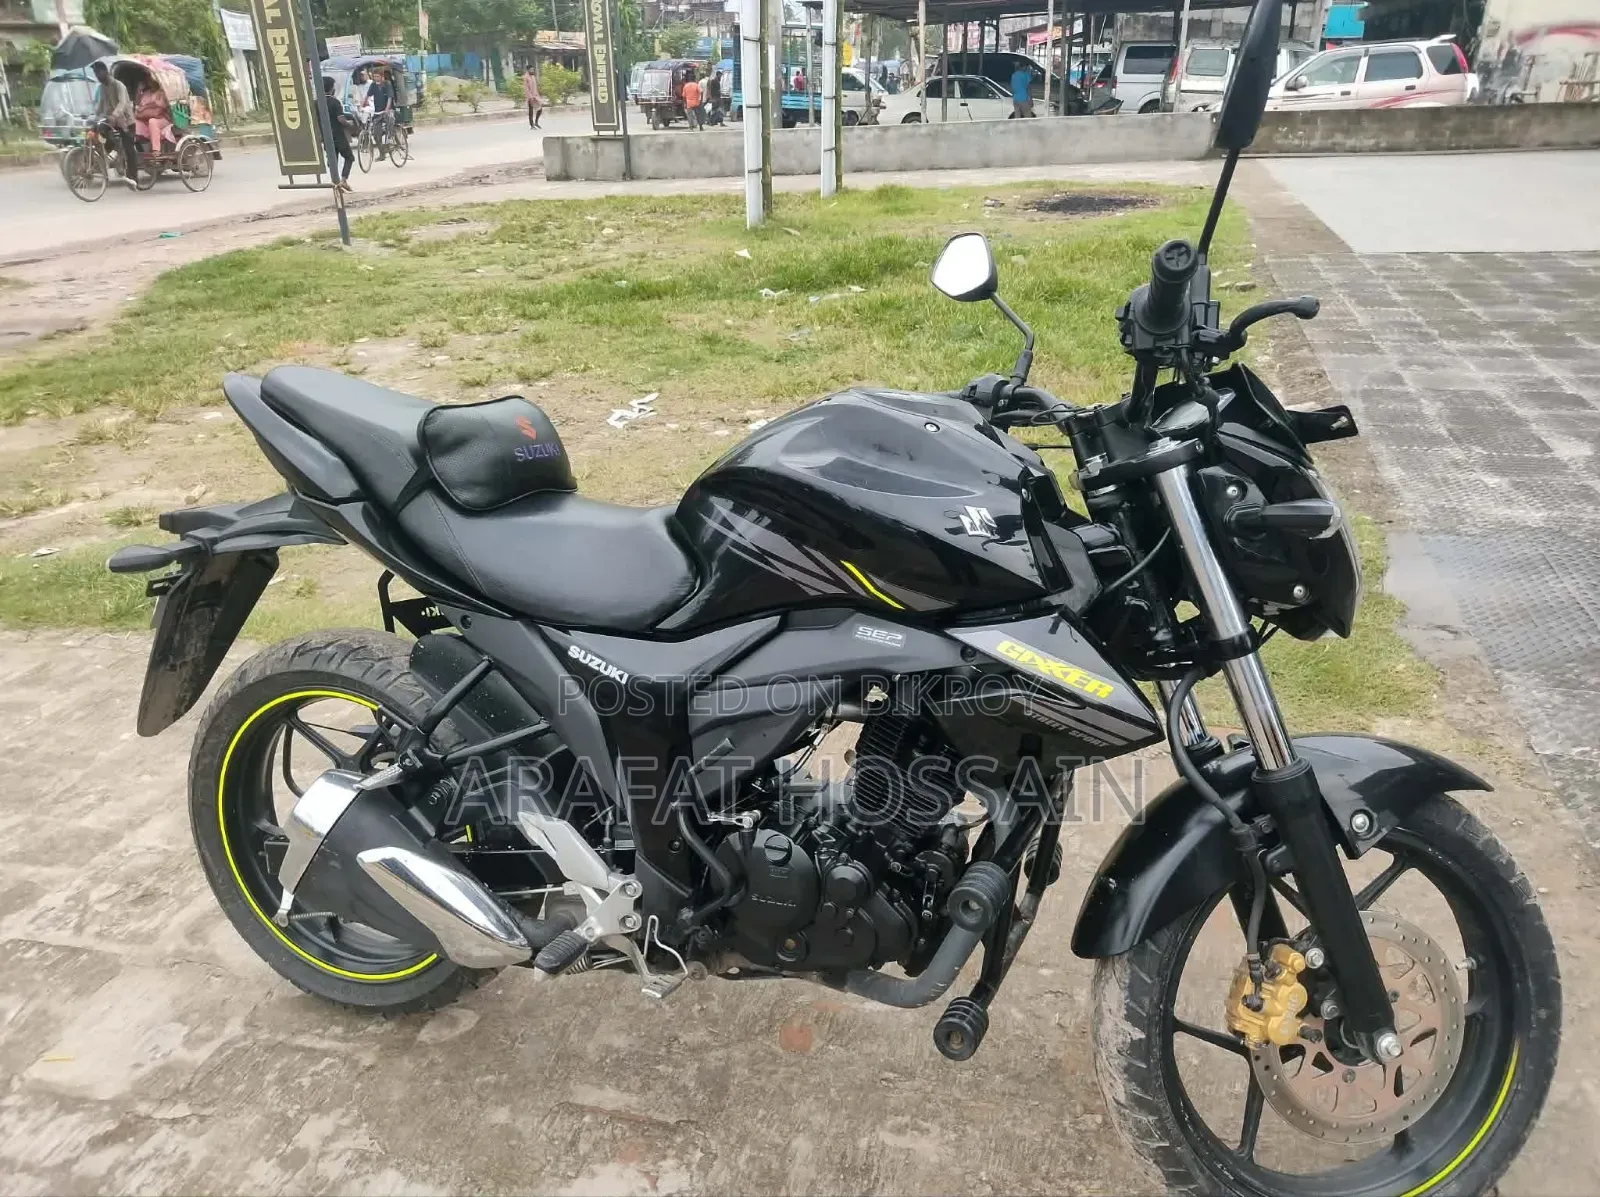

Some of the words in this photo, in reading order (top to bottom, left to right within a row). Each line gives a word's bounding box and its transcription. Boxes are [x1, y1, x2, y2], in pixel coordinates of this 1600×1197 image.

[590, 0, 604, 42] OYAL
[266, 28, 301, 130] ENFIELD
[593, 44, 609, 104] ENFIELD
[514, 443, 561, 462] SUZUKI
[567, 644, 629, 685] SUZUKI
[996, 640, 1114, 699] GIXXER
[1069, 730, 1112, 748] SPORT
